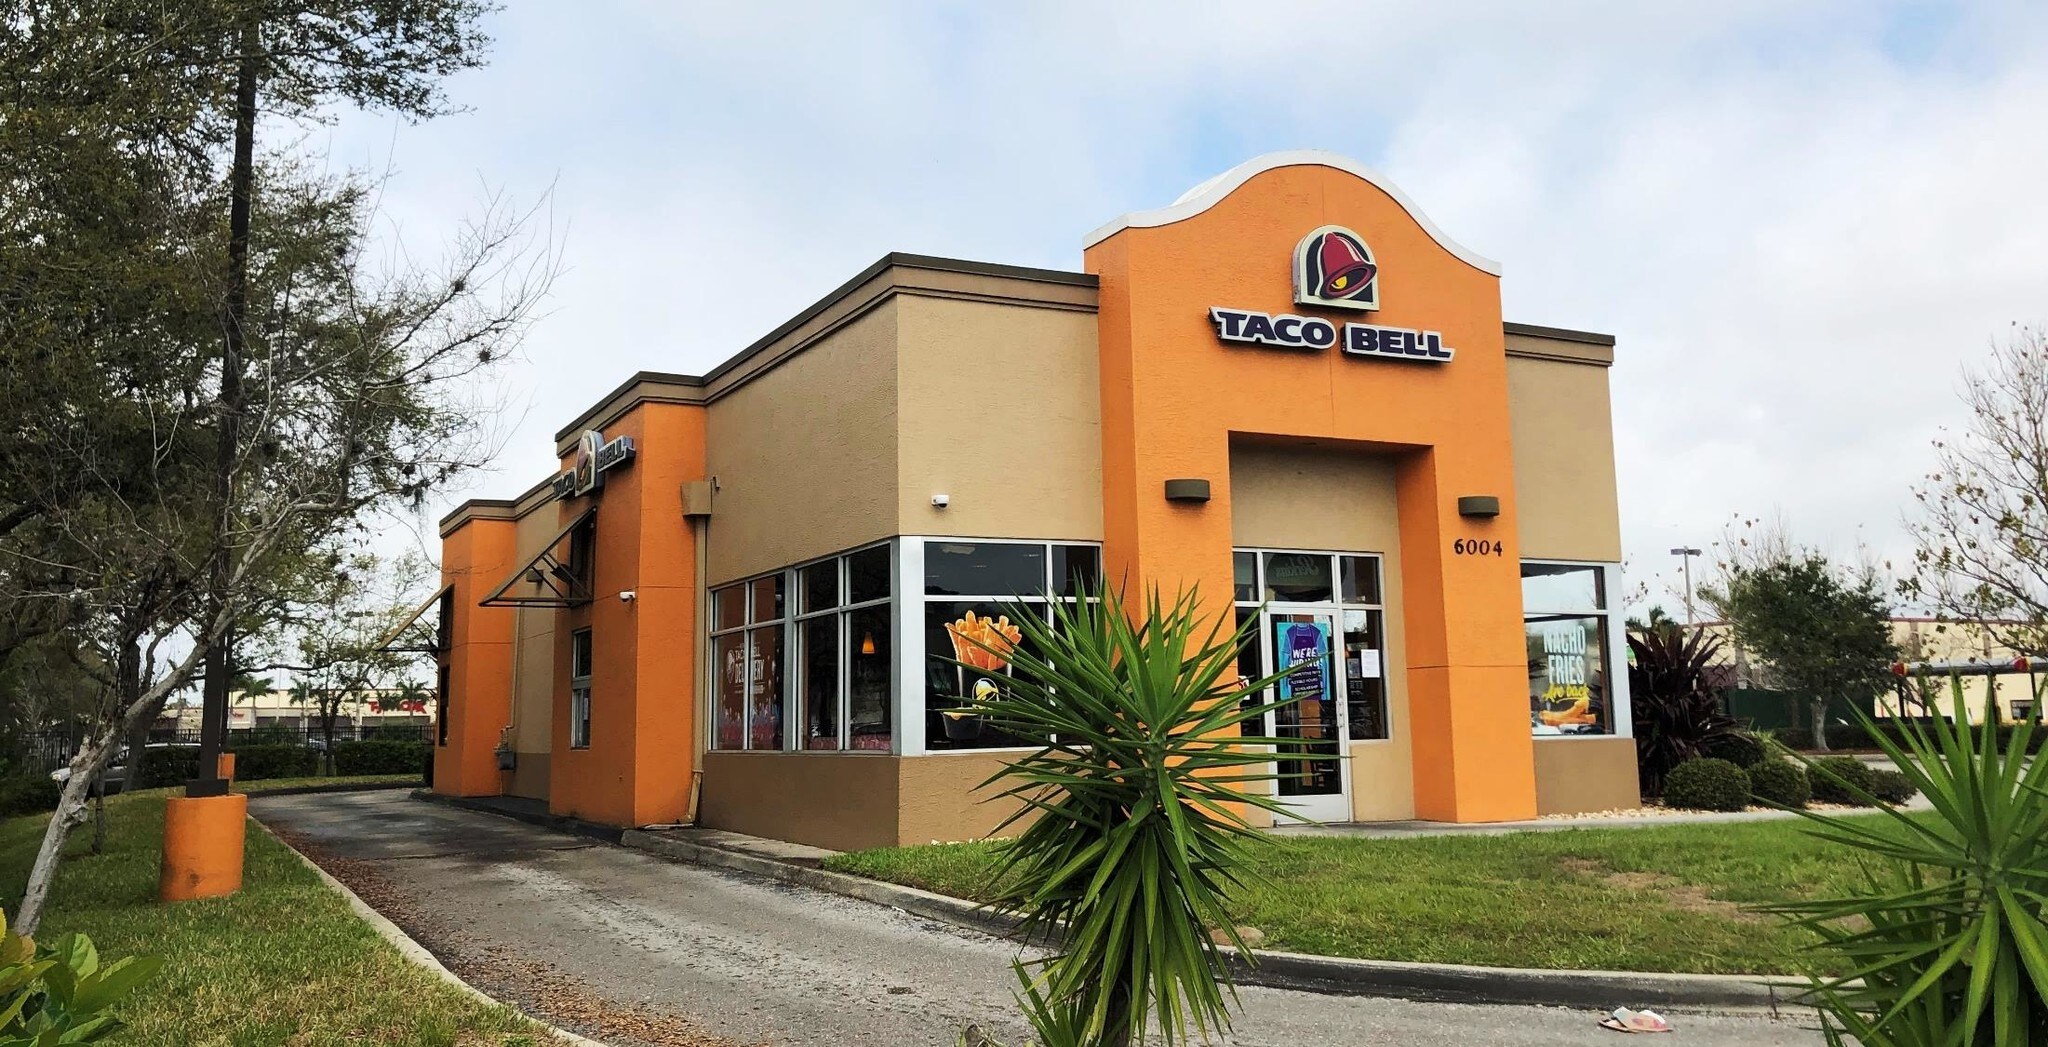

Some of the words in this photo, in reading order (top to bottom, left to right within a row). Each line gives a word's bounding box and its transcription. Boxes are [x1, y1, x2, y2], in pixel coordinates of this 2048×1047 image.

[1217, 311, 1335, 346] TACO
[1350, 327, 1451, 358] BELL
[597, 439, 625, 471] BELL
[1454, 538, 1503, 557] 6004
[1543, 625, 1586, 655] NACHO
[1548, 655, 1585, 685] FRIES
